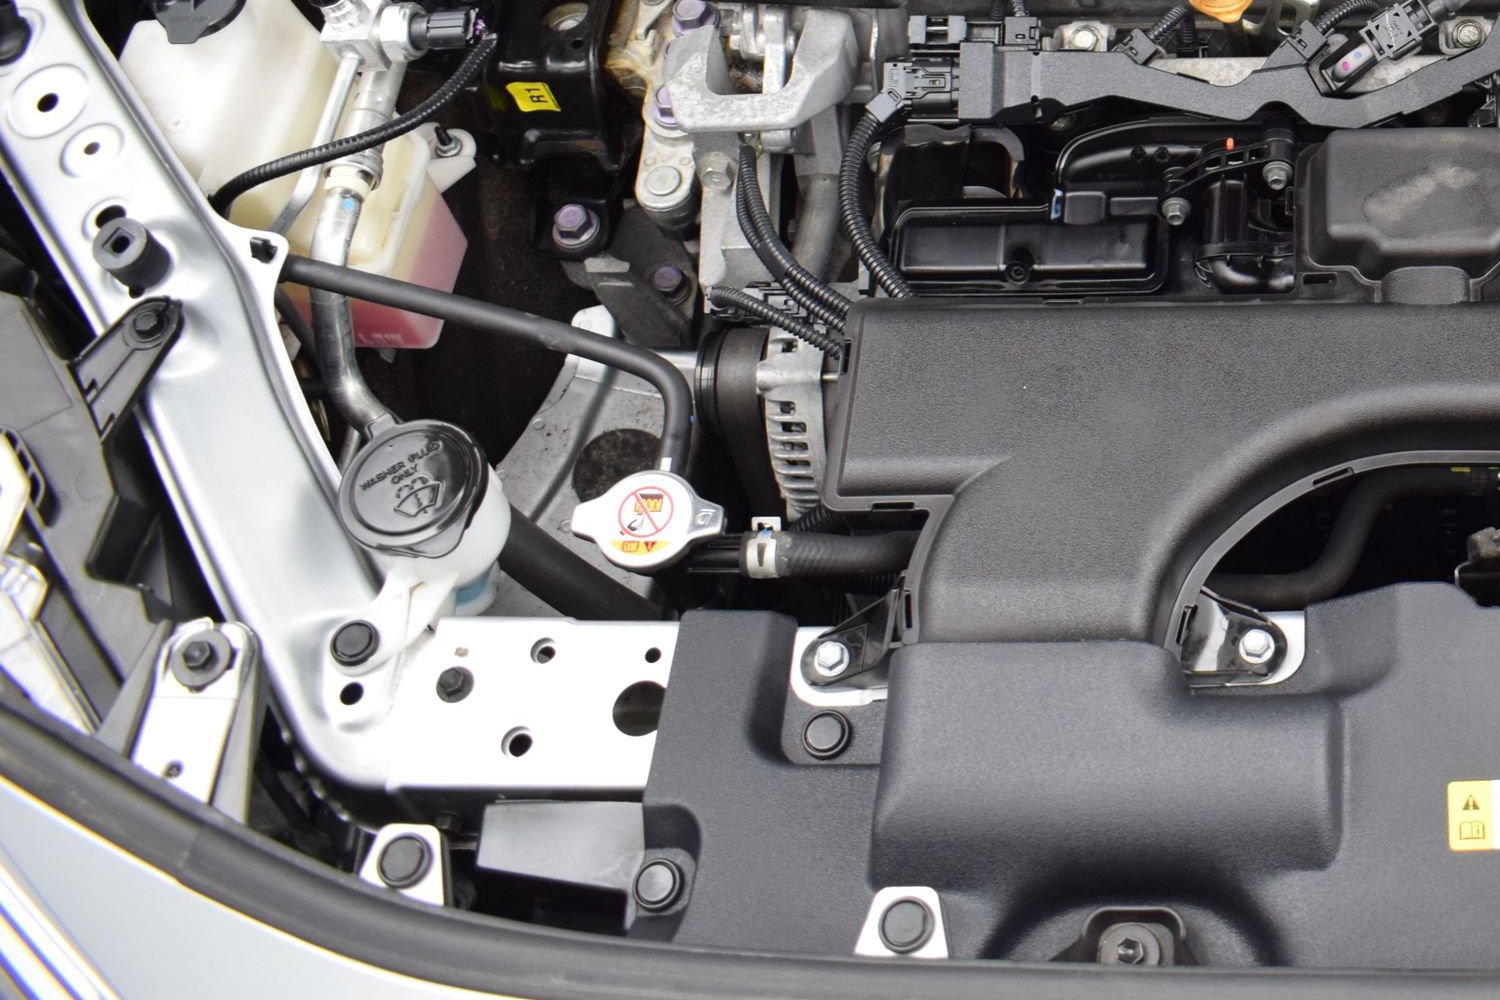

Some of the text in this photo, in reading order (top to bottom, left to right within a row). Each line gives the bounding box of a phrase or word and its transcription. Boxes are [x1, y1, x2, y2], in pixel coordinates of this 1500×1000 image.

[525, 88, 549, 104] R1
[360, 442, 441, 491] WASHER FLUID
[391, 463, 418, 485] ONLY
